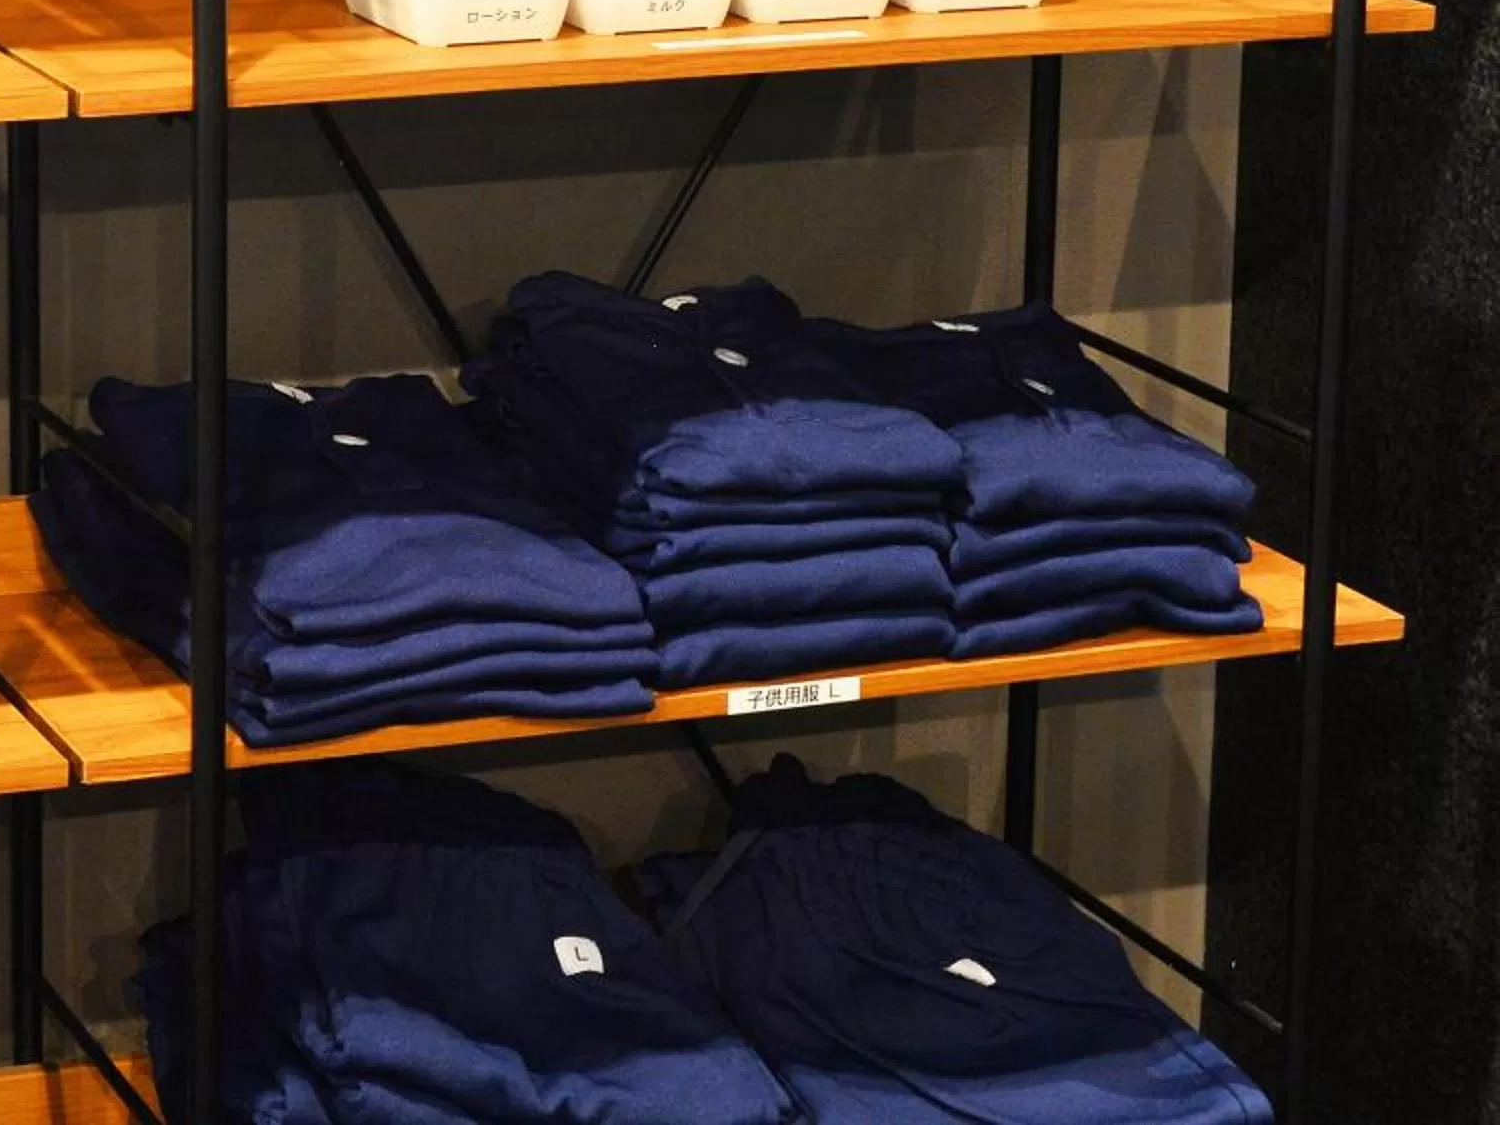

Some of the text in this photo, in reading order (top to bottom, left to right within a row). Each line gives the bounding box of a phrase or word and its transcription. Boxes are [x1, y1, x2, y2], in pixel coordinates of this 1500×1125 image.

[467, 7, 538, 23] ローション
[747, 683, 841, 709] 子供用服 L
[575, 947, 589, 963] L
